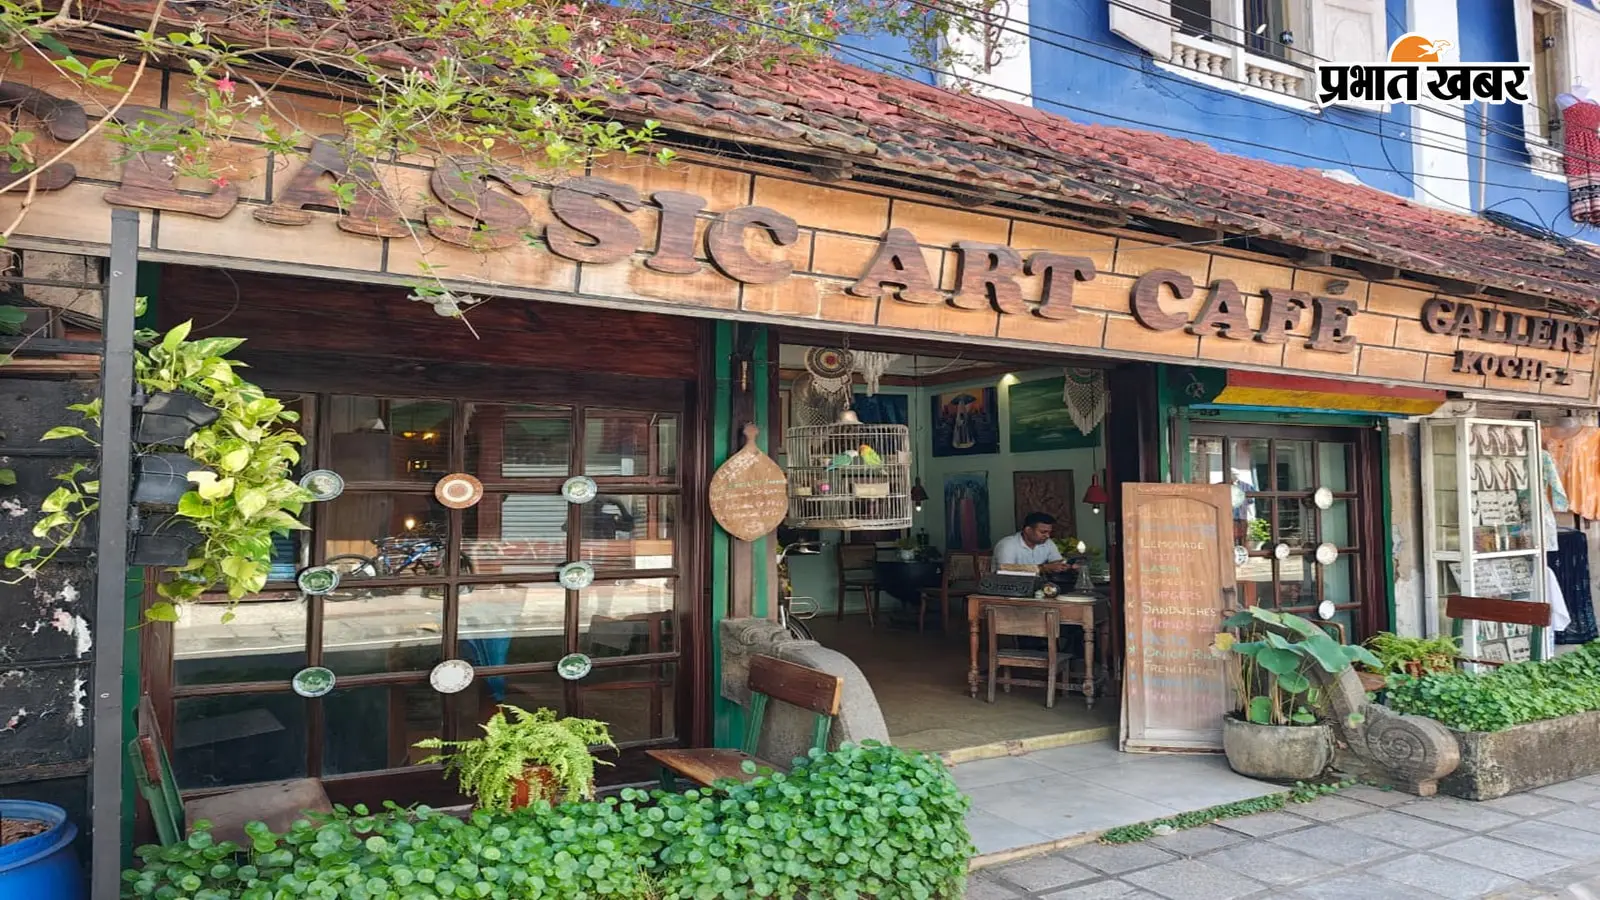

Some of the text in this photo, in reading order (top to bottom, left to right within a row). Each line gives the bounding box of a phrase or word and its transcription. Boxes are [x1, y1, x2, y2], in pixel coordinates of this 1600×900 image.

[843, 227, 1096, 320] ART
[1129, 268, 1358, 354] CAFÉ
[1421, 298, 1597, 353] GALLERY
